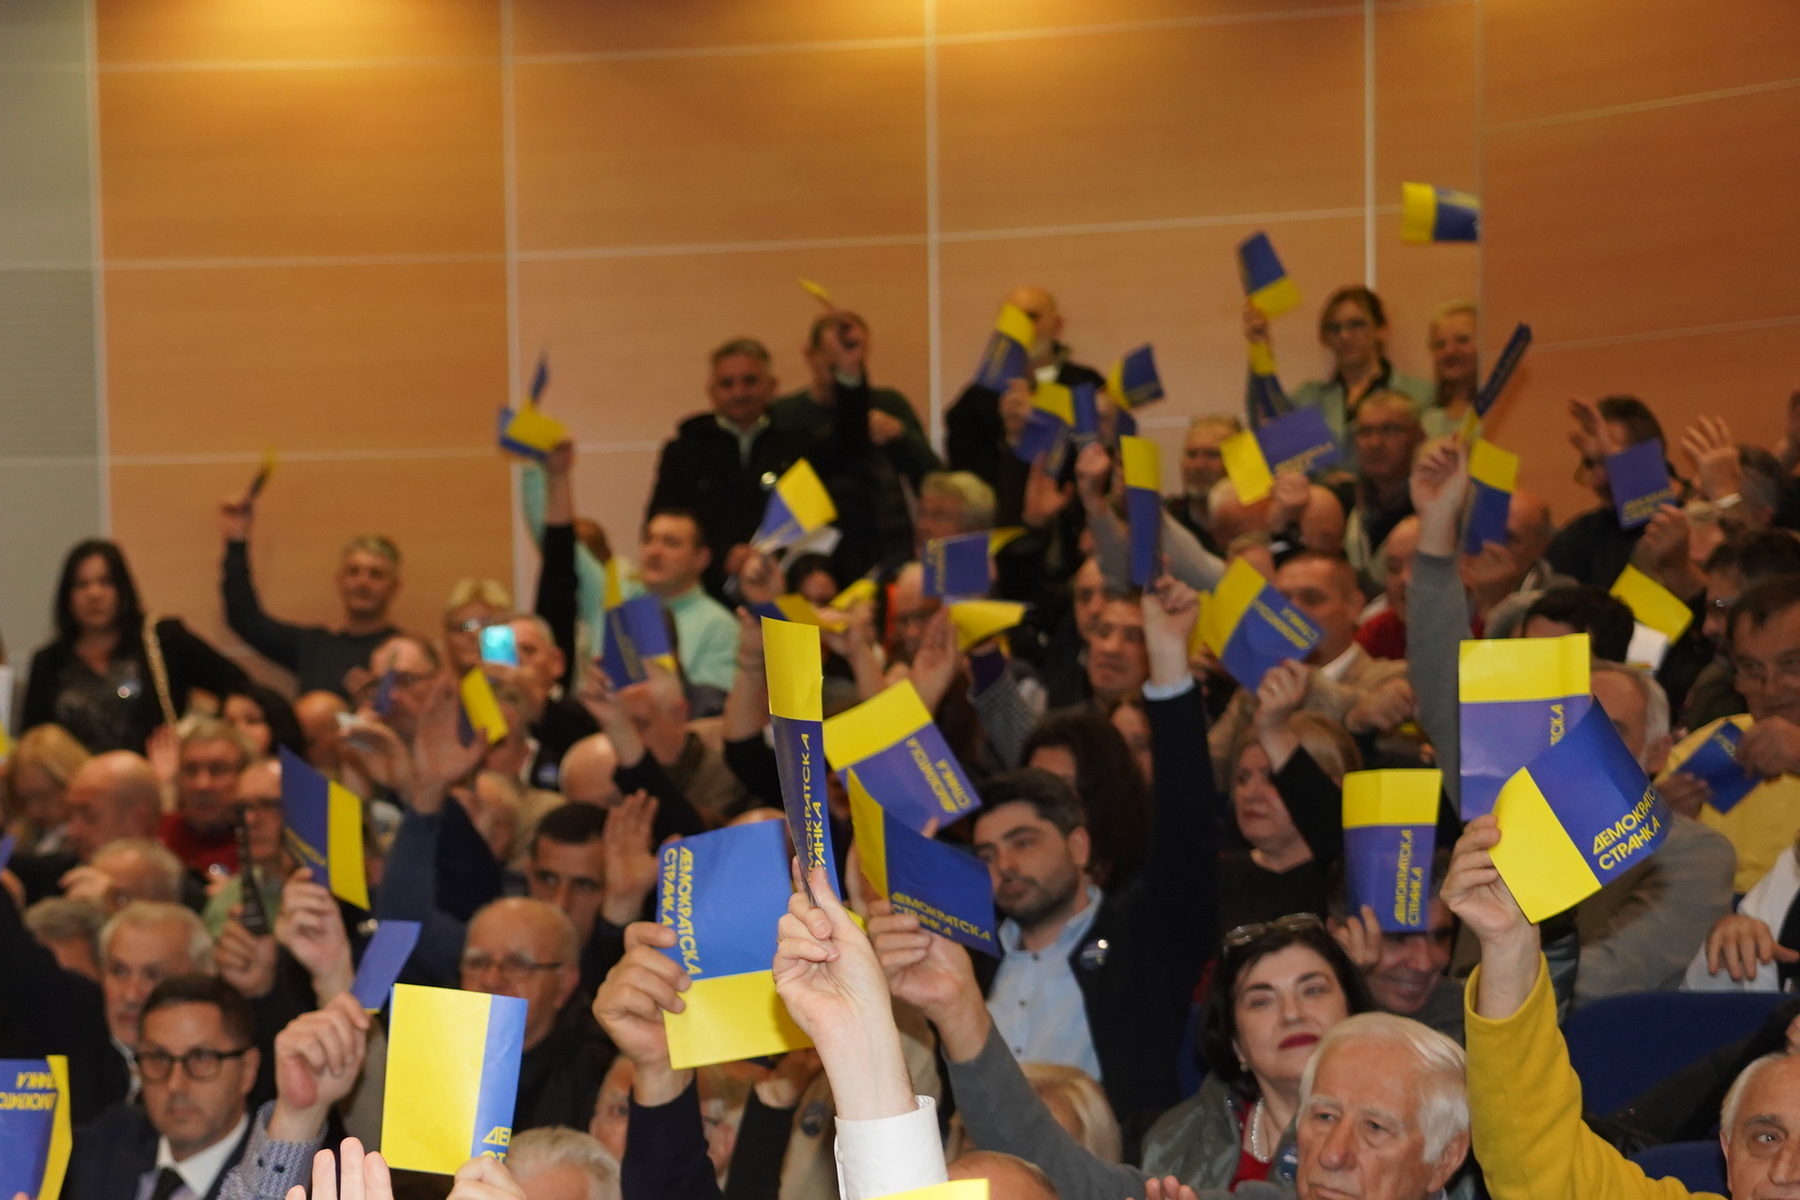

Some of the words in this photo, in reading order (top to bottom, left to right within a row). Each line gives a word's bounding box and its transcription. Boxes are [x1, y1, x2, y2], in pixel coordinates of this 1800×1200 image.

[801, 733, 817, 878] МОКРАТСКА
[1598, 814, 1662, 870] СТРАНКА
[661, 847, 678, 927] СТРАНКА
[677, 846, 702, 975] ДЕМОКРАТСКА
